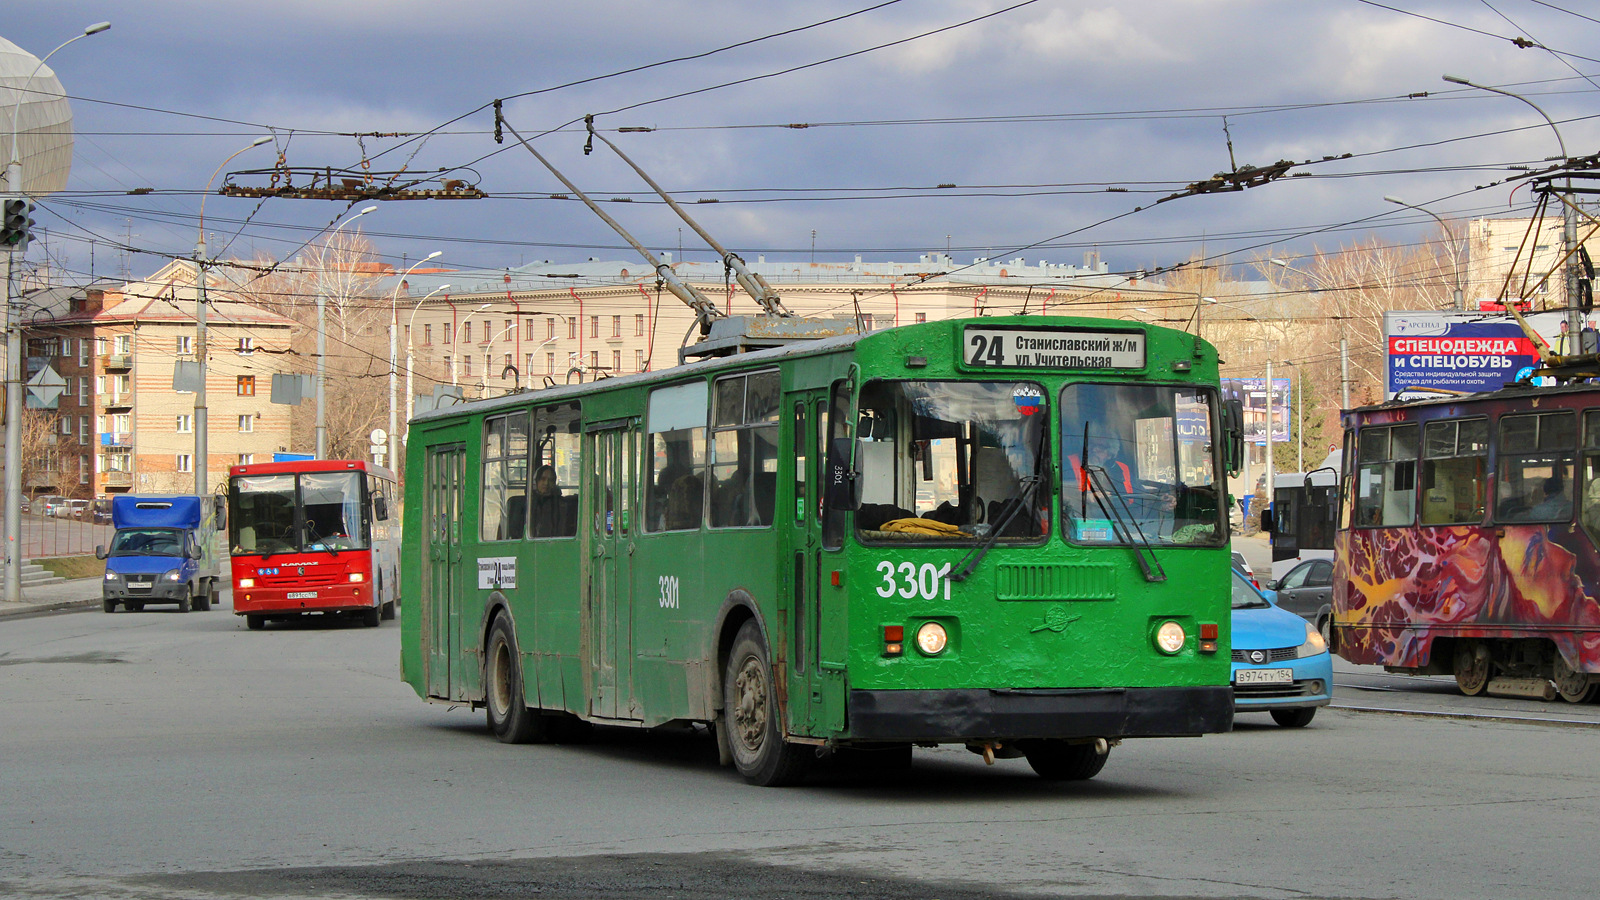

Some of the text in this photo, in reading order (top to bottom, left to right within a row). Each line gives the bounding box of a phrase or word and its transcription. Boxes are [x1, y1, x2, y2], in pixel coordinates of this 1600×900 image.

[970, 335, 1005, 366] 24
[1015, 336, 1137, 352] Станиславский ж/м
[1394, 340, 1517, 354] СПЕЦОДЕЖДА
[1015, 353, 1112, 367] ул. Учительская
[1395, 356, 1512, 370] и СПЕЦОБУВЬ
[1433, 378, 1460, 386] рыбалки
[833, 465, 843, 485] 3301
[494, 562, 502, 584] 24
[875, 560, 951, 601] 3301
[658, 575, 679, 609] 3301
[1239, 670, 1291, 682] В974ТУ 154
